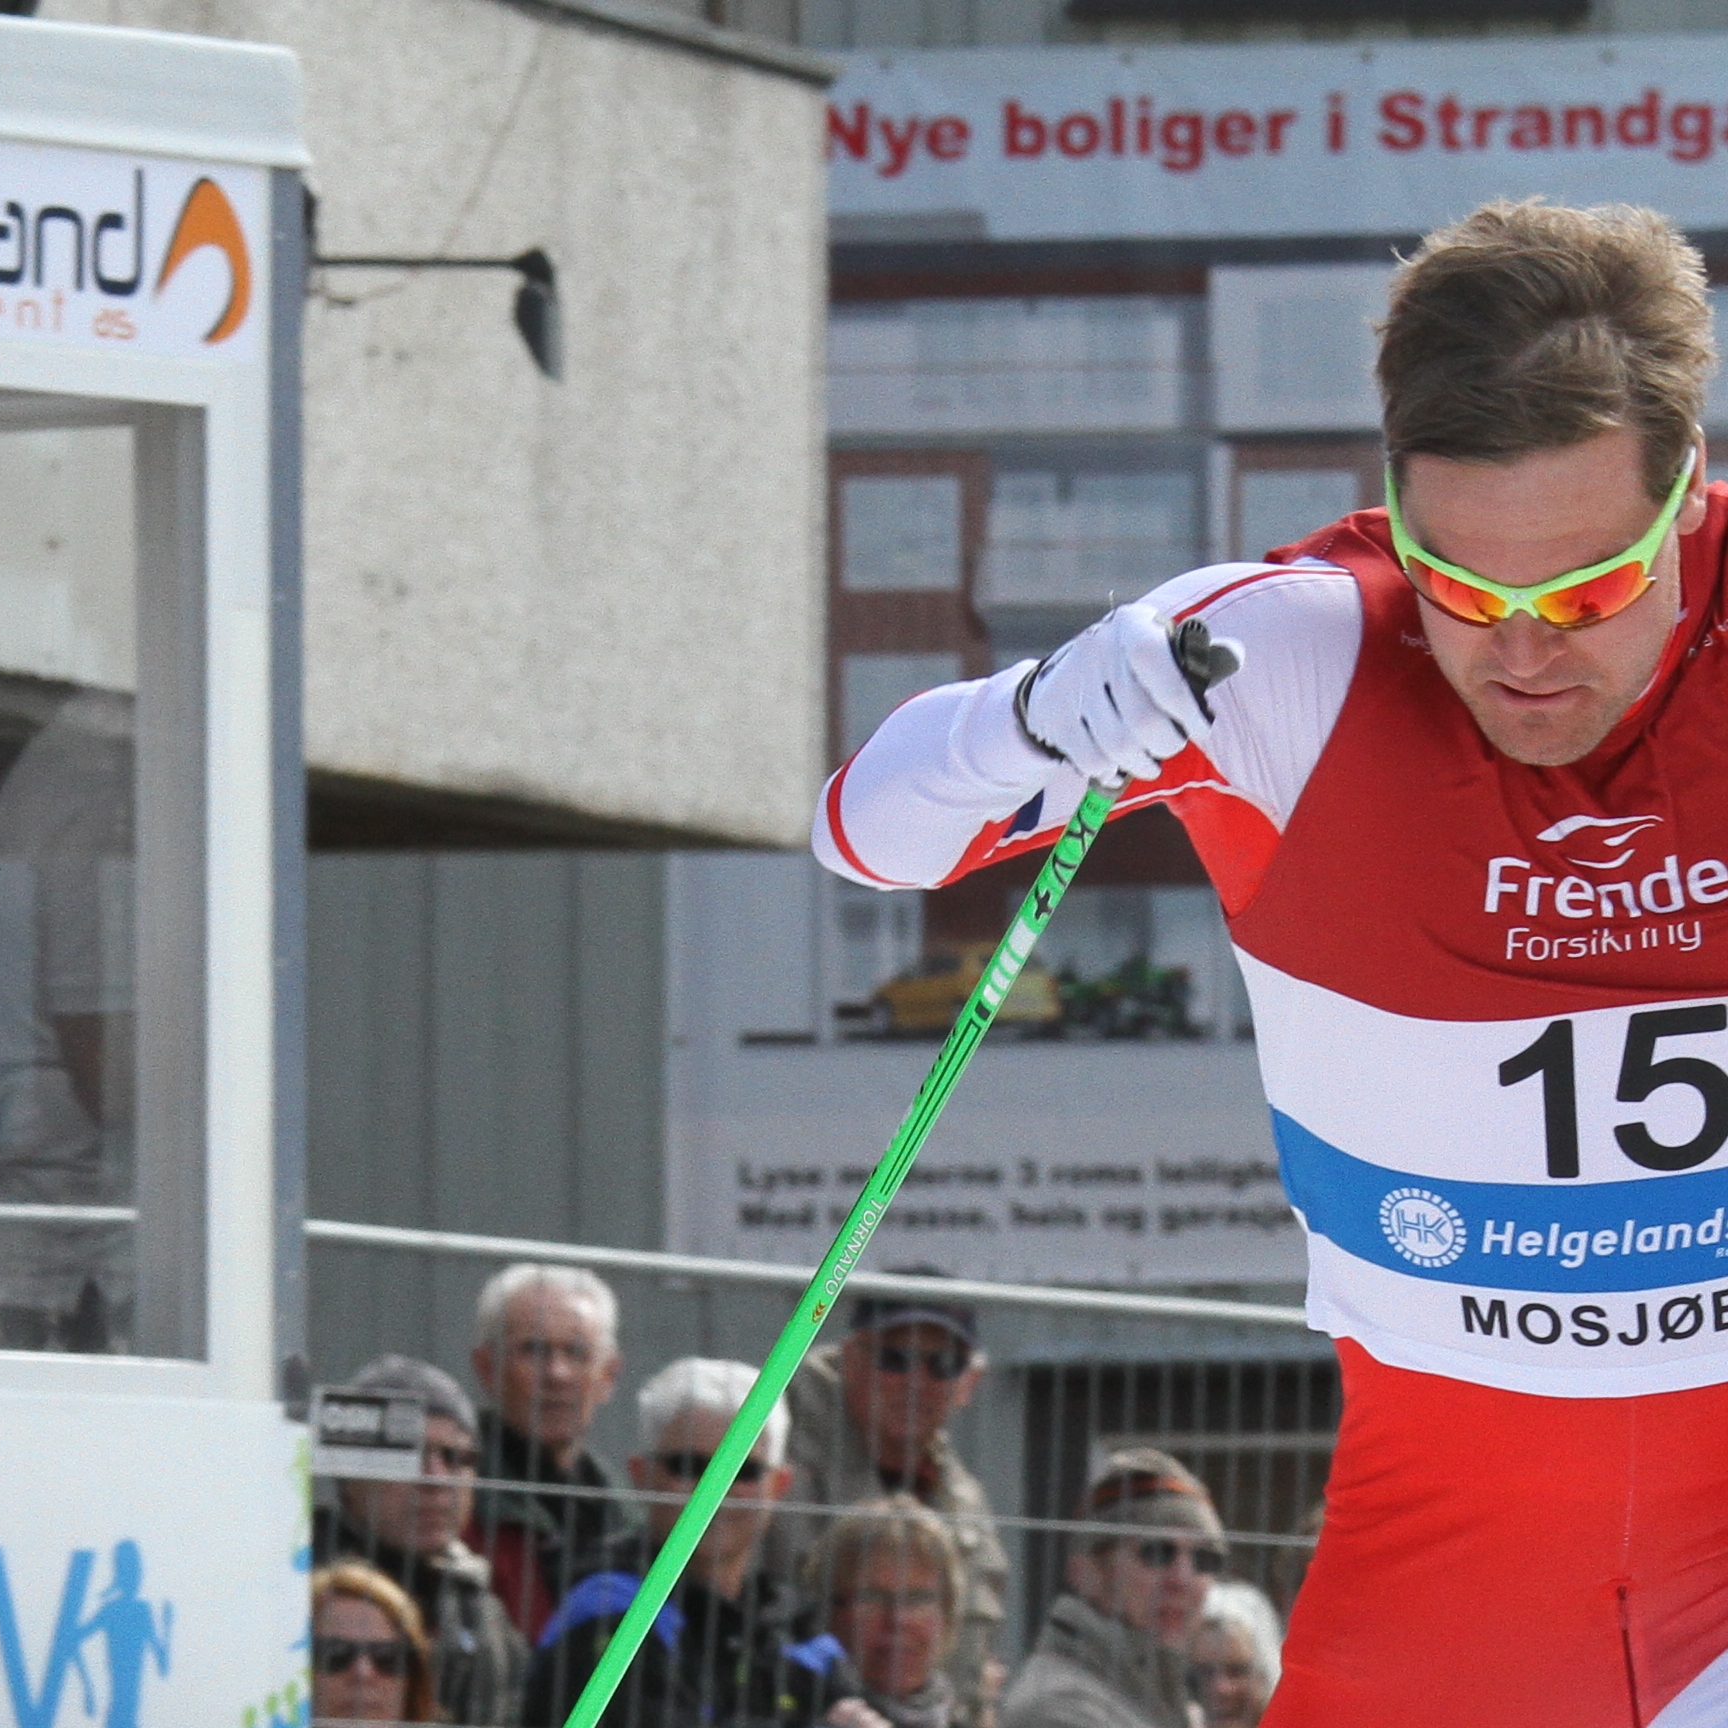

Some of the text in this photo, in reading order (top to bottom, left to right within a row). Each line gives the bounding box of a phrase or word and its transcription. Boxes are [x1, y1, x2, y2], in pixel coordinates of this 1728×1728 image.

[826, 99, 972, 178] Nye
[1002, 96, 1297, 173] boliger
[1327, 91, 1346, 153] i
[92, 307, 138, 342] as
[824, 1197, 887, 1296] TORNADO
